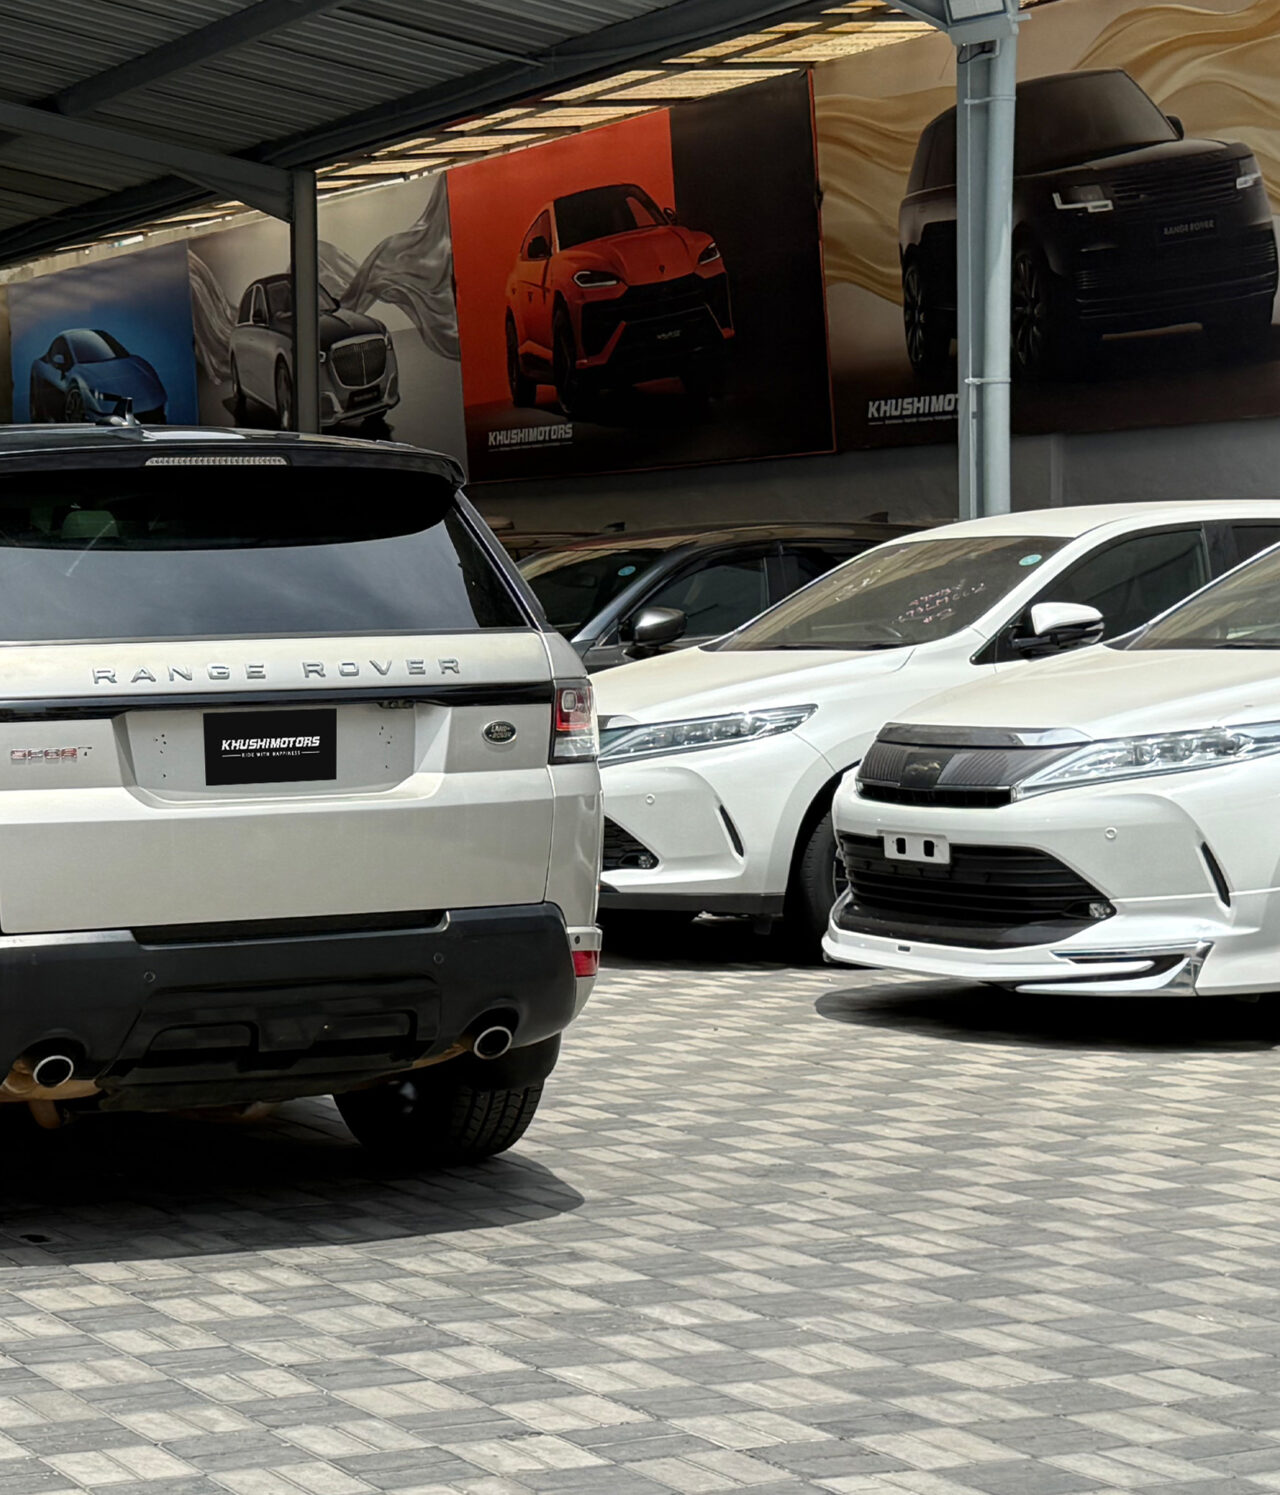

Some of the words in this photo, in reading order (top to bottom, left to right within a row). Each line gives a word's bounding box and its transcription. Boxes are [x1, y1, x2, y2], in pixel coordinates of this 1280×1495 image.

[487, 423, 574, 446] KHUSHIMOTORS
[92, 662, 267, 685] RANGE
[303, 657, 461, 679] ROVER
[221, 735, 321, 751] KHUSHIMOTORS
